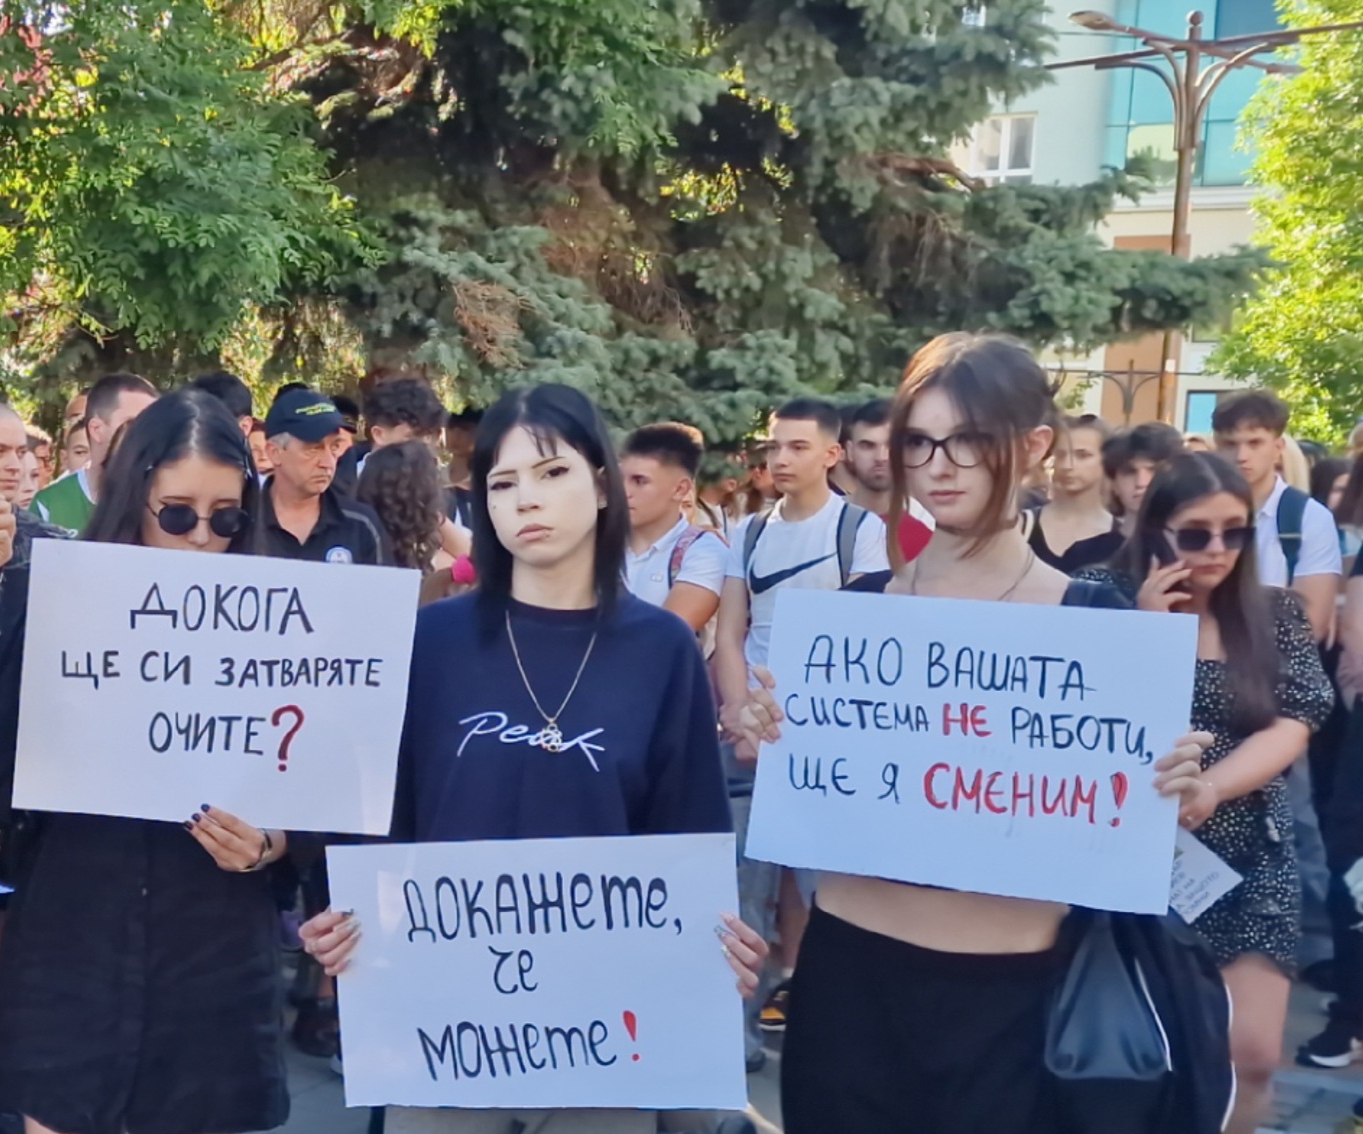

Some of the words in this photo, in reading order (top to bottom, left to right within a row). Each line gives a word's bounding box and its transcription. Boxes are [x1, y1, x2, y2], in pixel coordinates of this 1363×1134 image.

[129, 582, 314, 635] ДОКОГА
[61, 650, 121, 690] ЩЕ
[140, 650, 192, 686] СИ
[214, 656, 384, 689] ЗАТВАРЯТЕ
[804, 634, 904, 687] АКО
[926, 640, 1097, 702] ВАШАТА
[149, 704, 305, 773] ОЧИТЕ?
[783, 692, 930, 733] СИСТЕМА
[941, 702, 993, 739] НЕ
[1010, 705, 1154, 765] РАБОТИ,
[787, 752, 857, 798] ЩЕ
[878, 762, 900, 804] Я
[923, 761, 1130, 829] СМЕНИМ!
